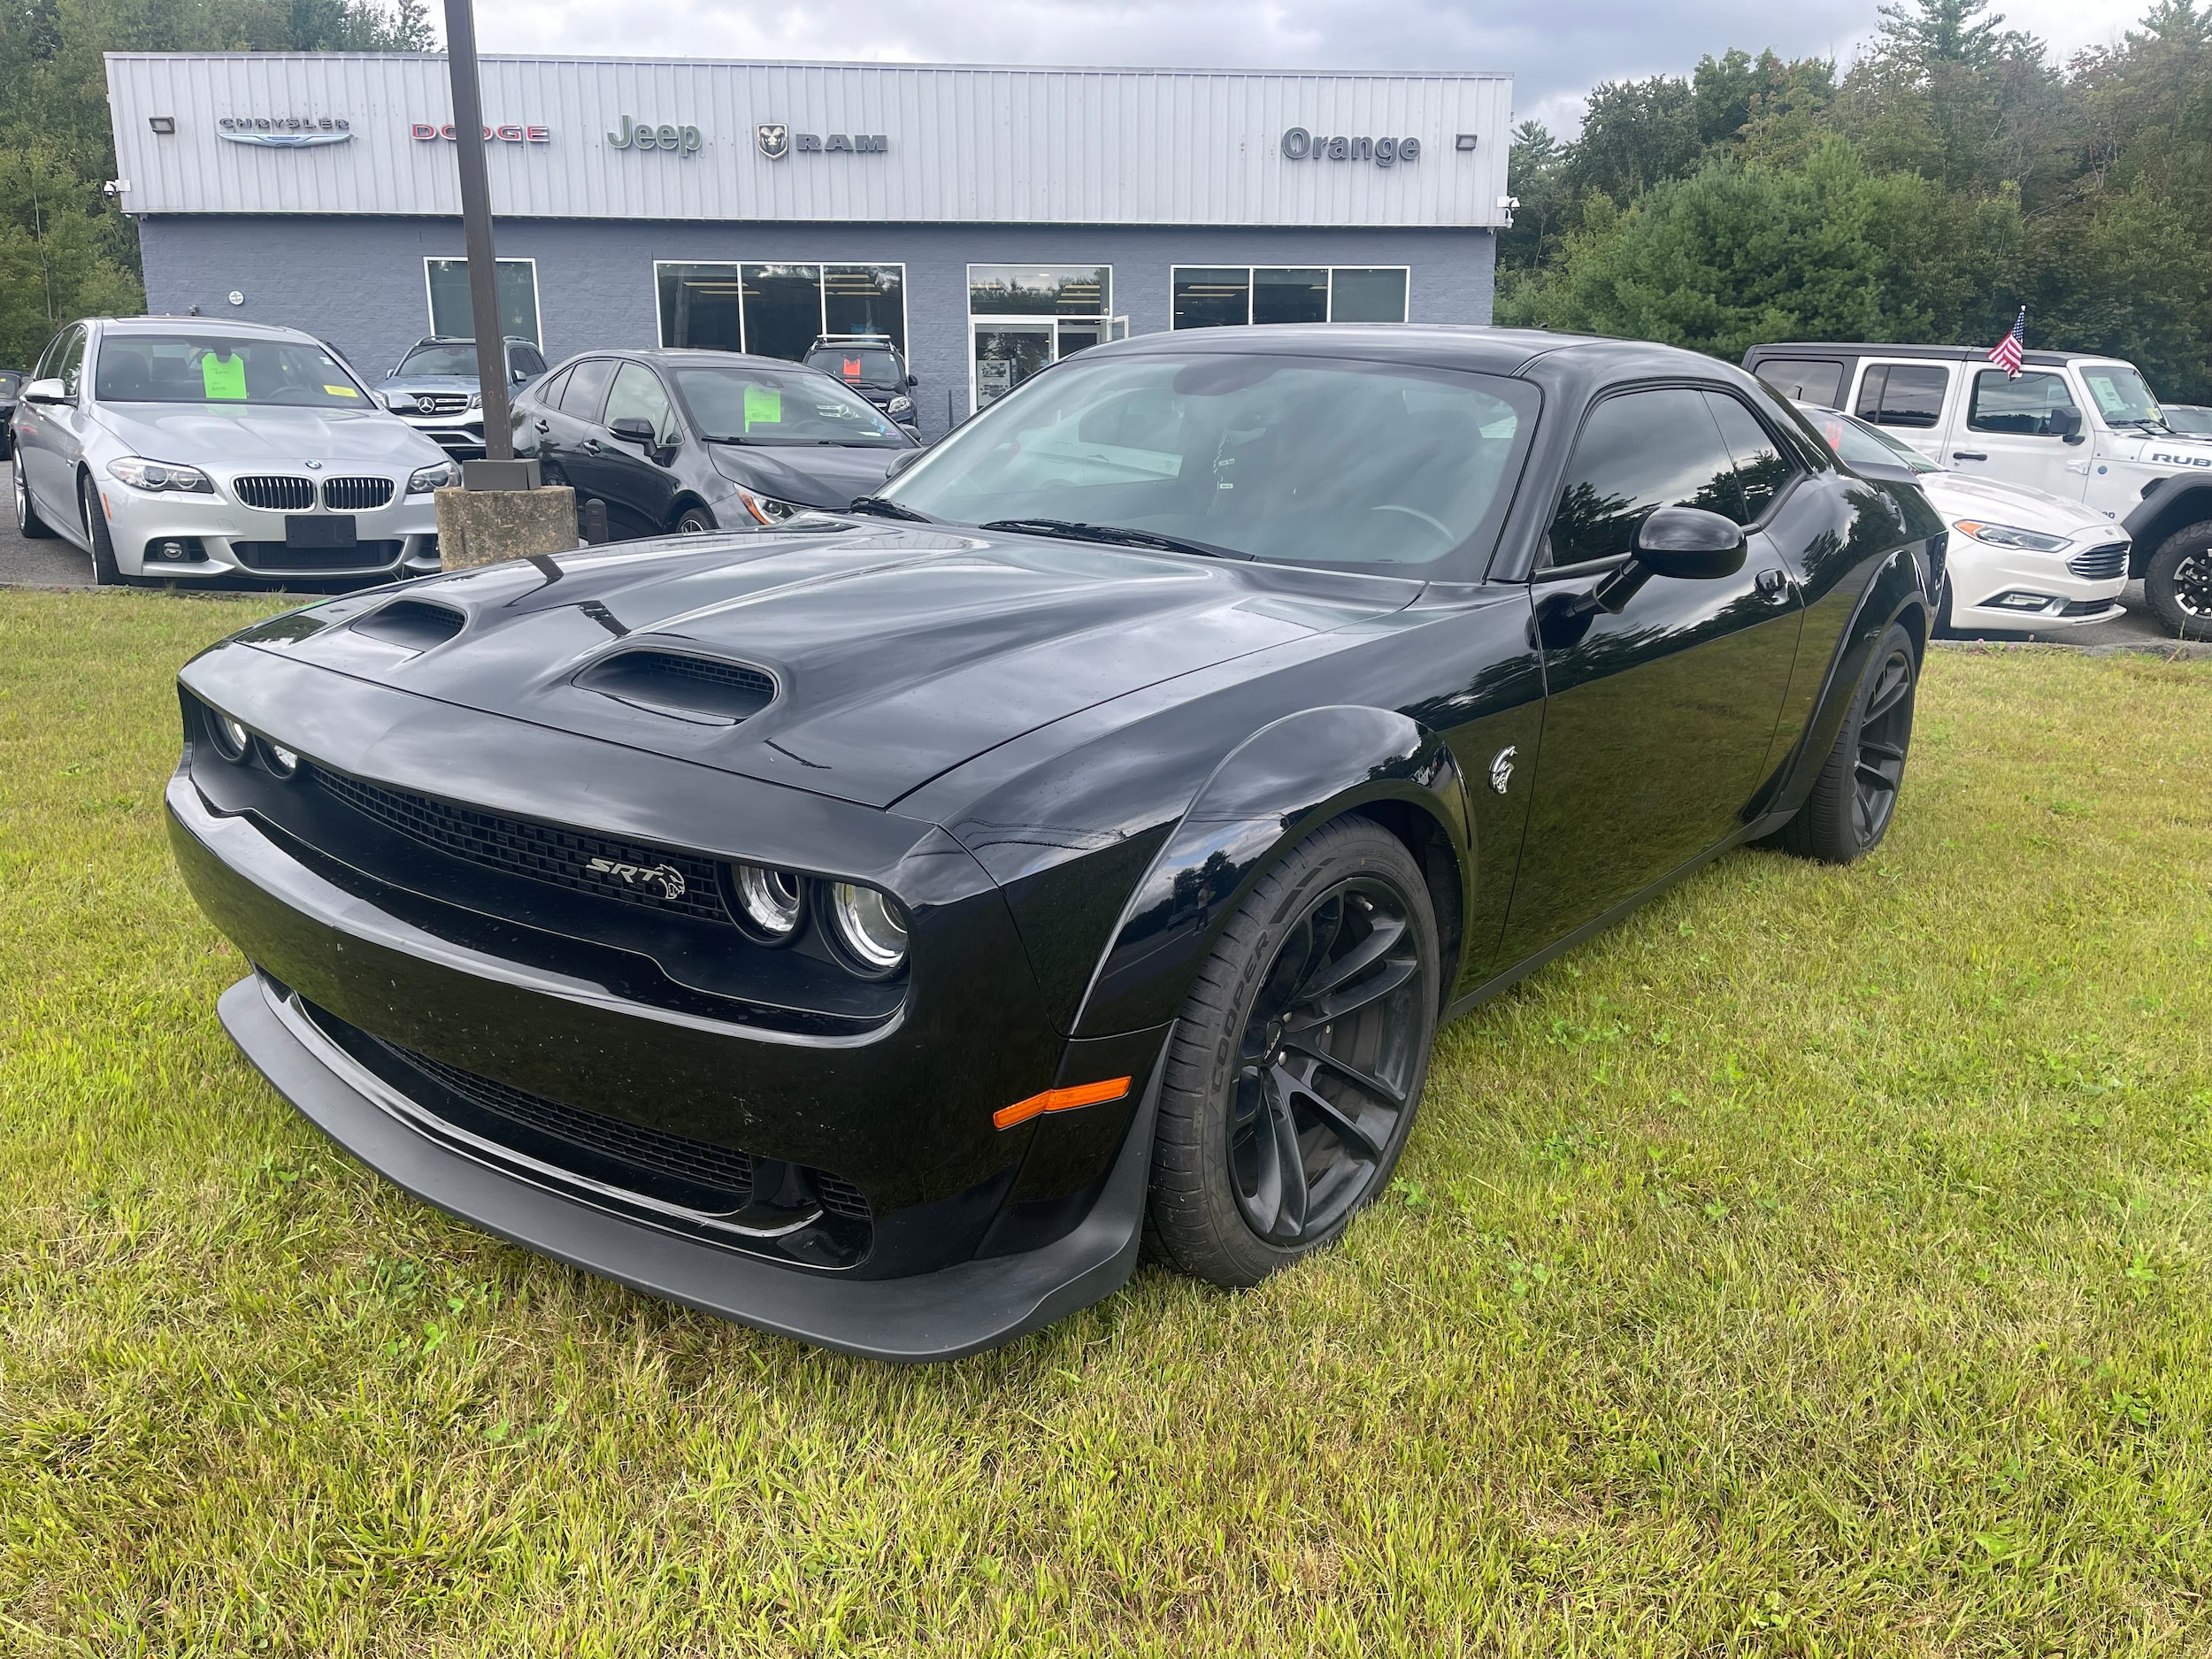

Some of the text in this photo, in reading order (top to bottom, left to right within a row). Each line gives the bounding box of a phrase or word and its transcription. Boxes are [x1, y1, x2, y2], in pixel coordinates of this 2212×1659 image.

[219, 118, 350, 130] CHRYSLER
[607, 114, 703, 158] Jeep
[795, 134, 889, 152] RAM
[1281, 127, 1422, 167] Orange
[585, 857, 665, 884] SRT
[1210, 929, 1270, 1094] COOPER
